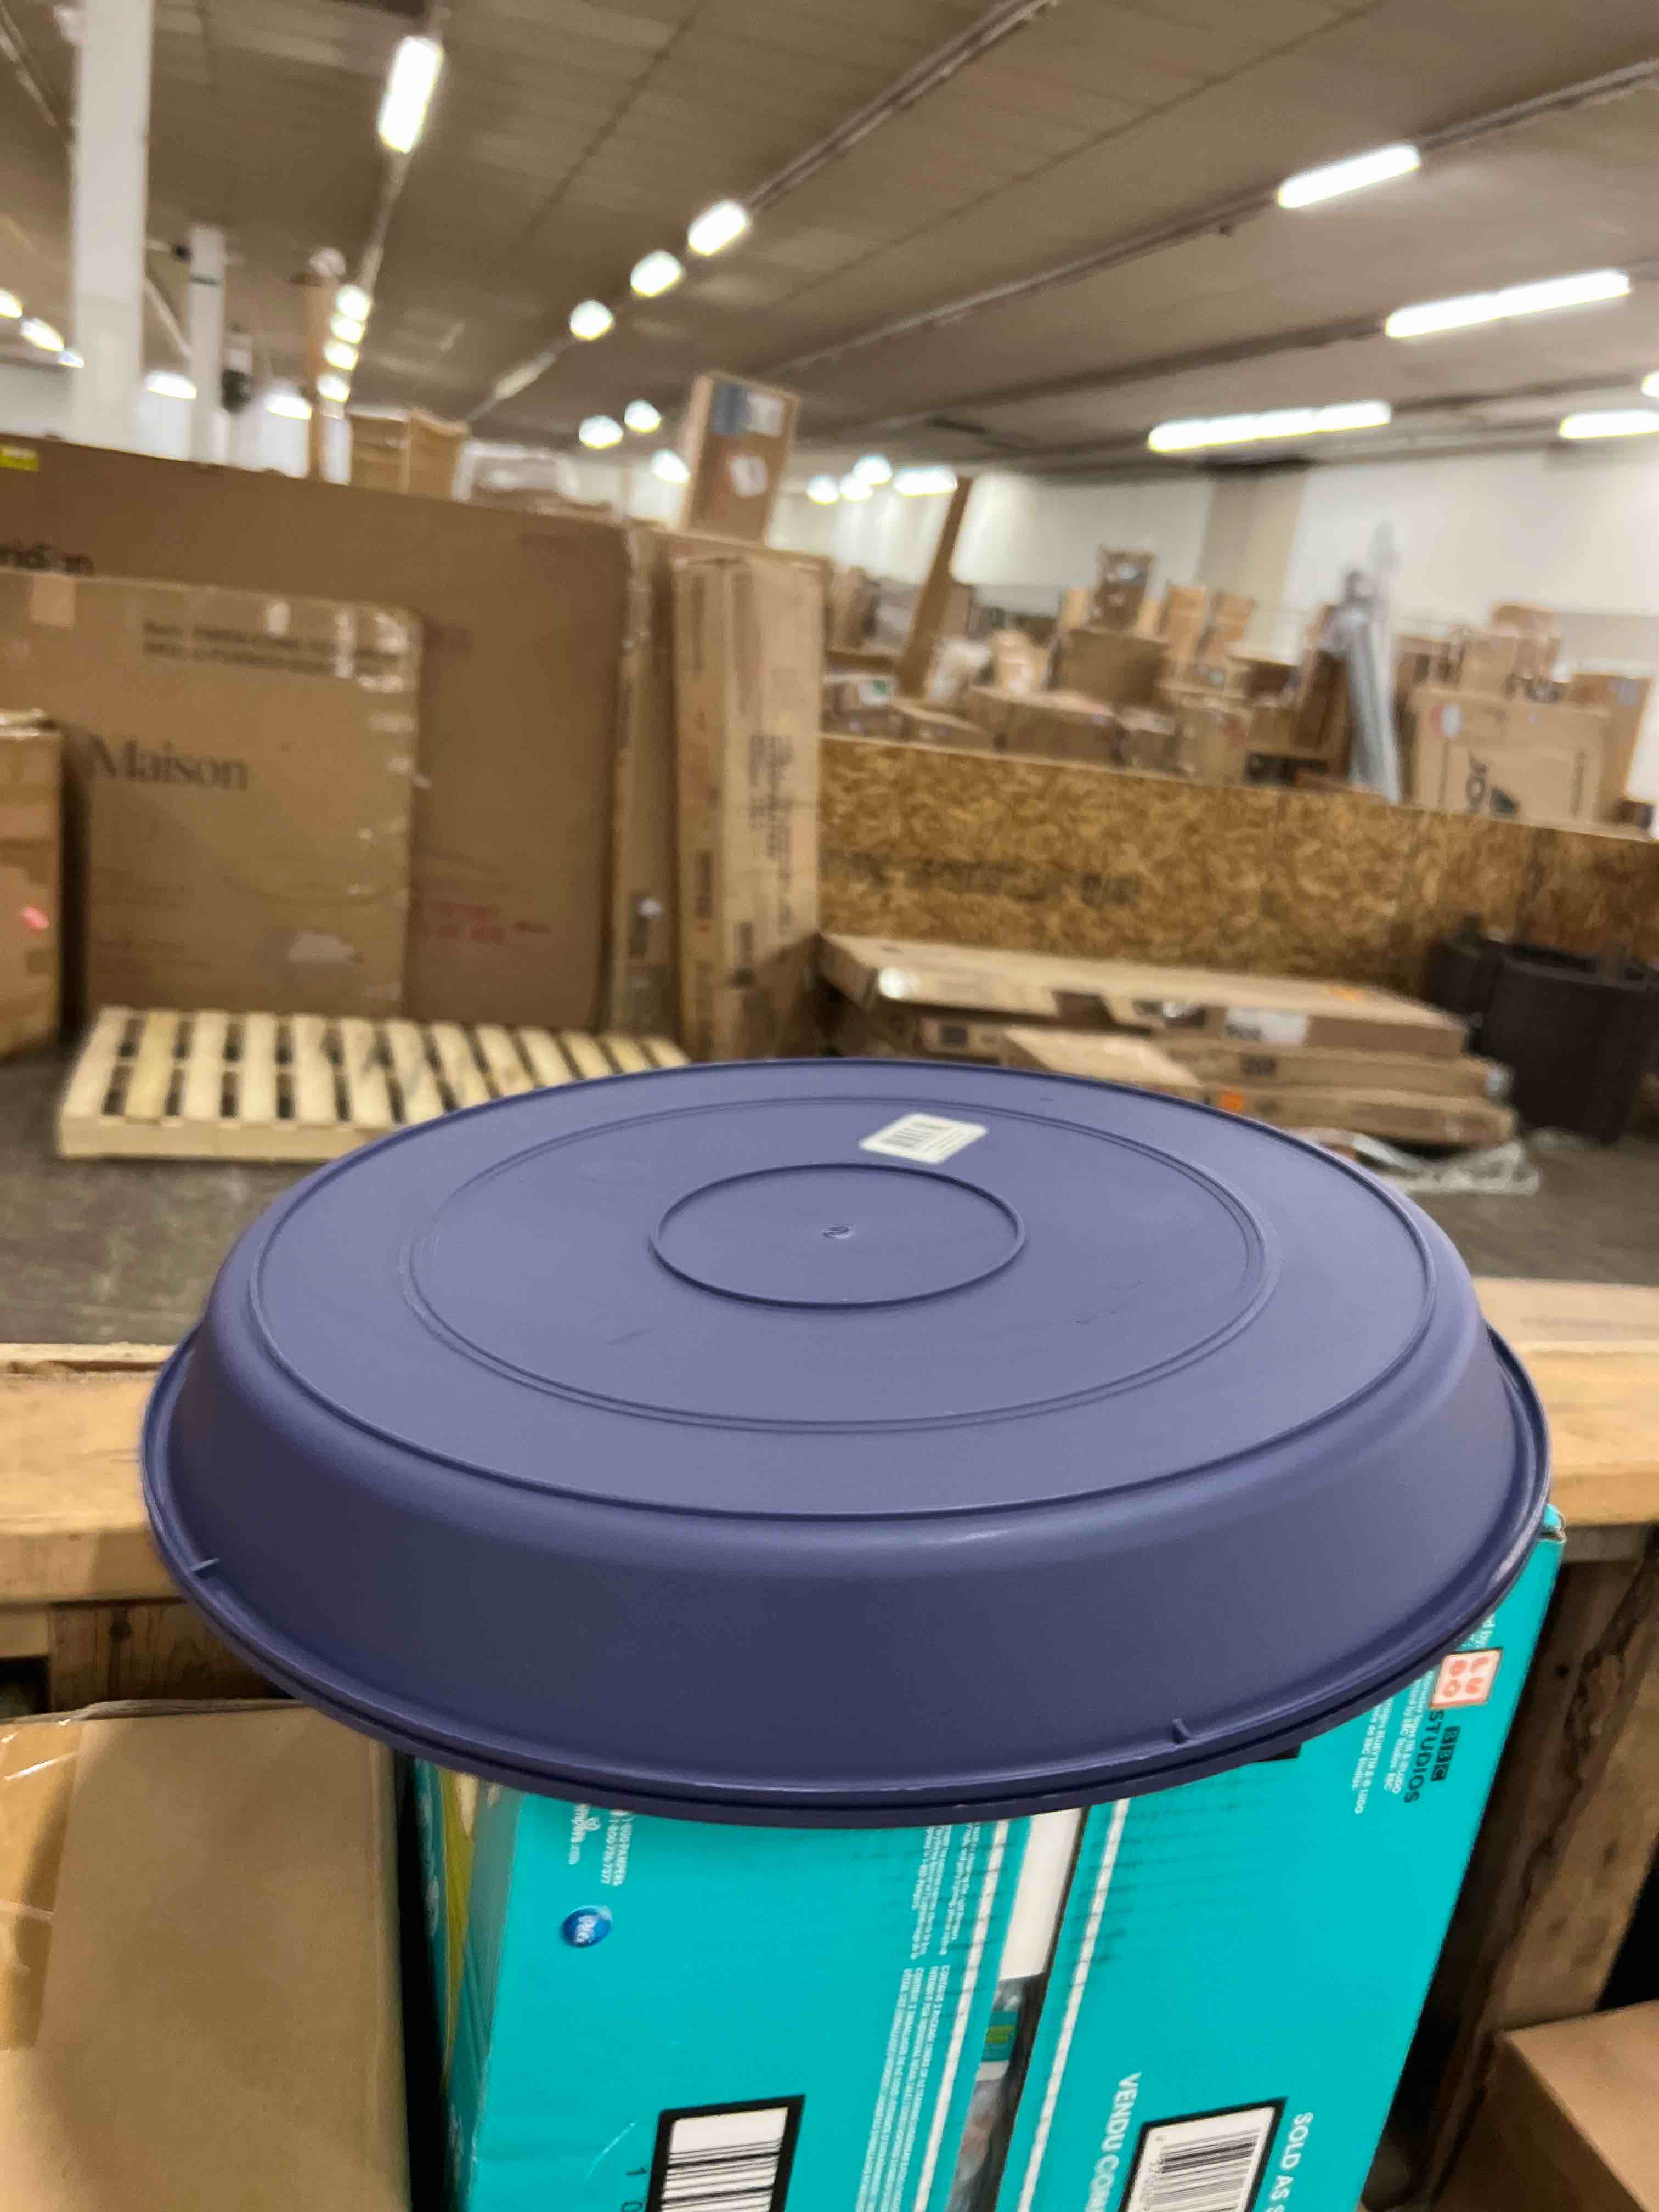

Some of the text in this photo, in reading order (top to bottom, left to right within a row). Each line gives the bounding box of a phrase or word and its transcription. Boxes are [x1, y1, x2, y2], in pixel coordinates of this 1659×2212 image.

[1404, 1710, 1445, 1803] STUDIOS
[1431, 1726, 1460, 1782] BBC
[1101, 2072, 1142, 2153] VENDU
[1281, 2112, 1314, 2171] SOLD
[1269, 2175, 1294, 2201] AS
